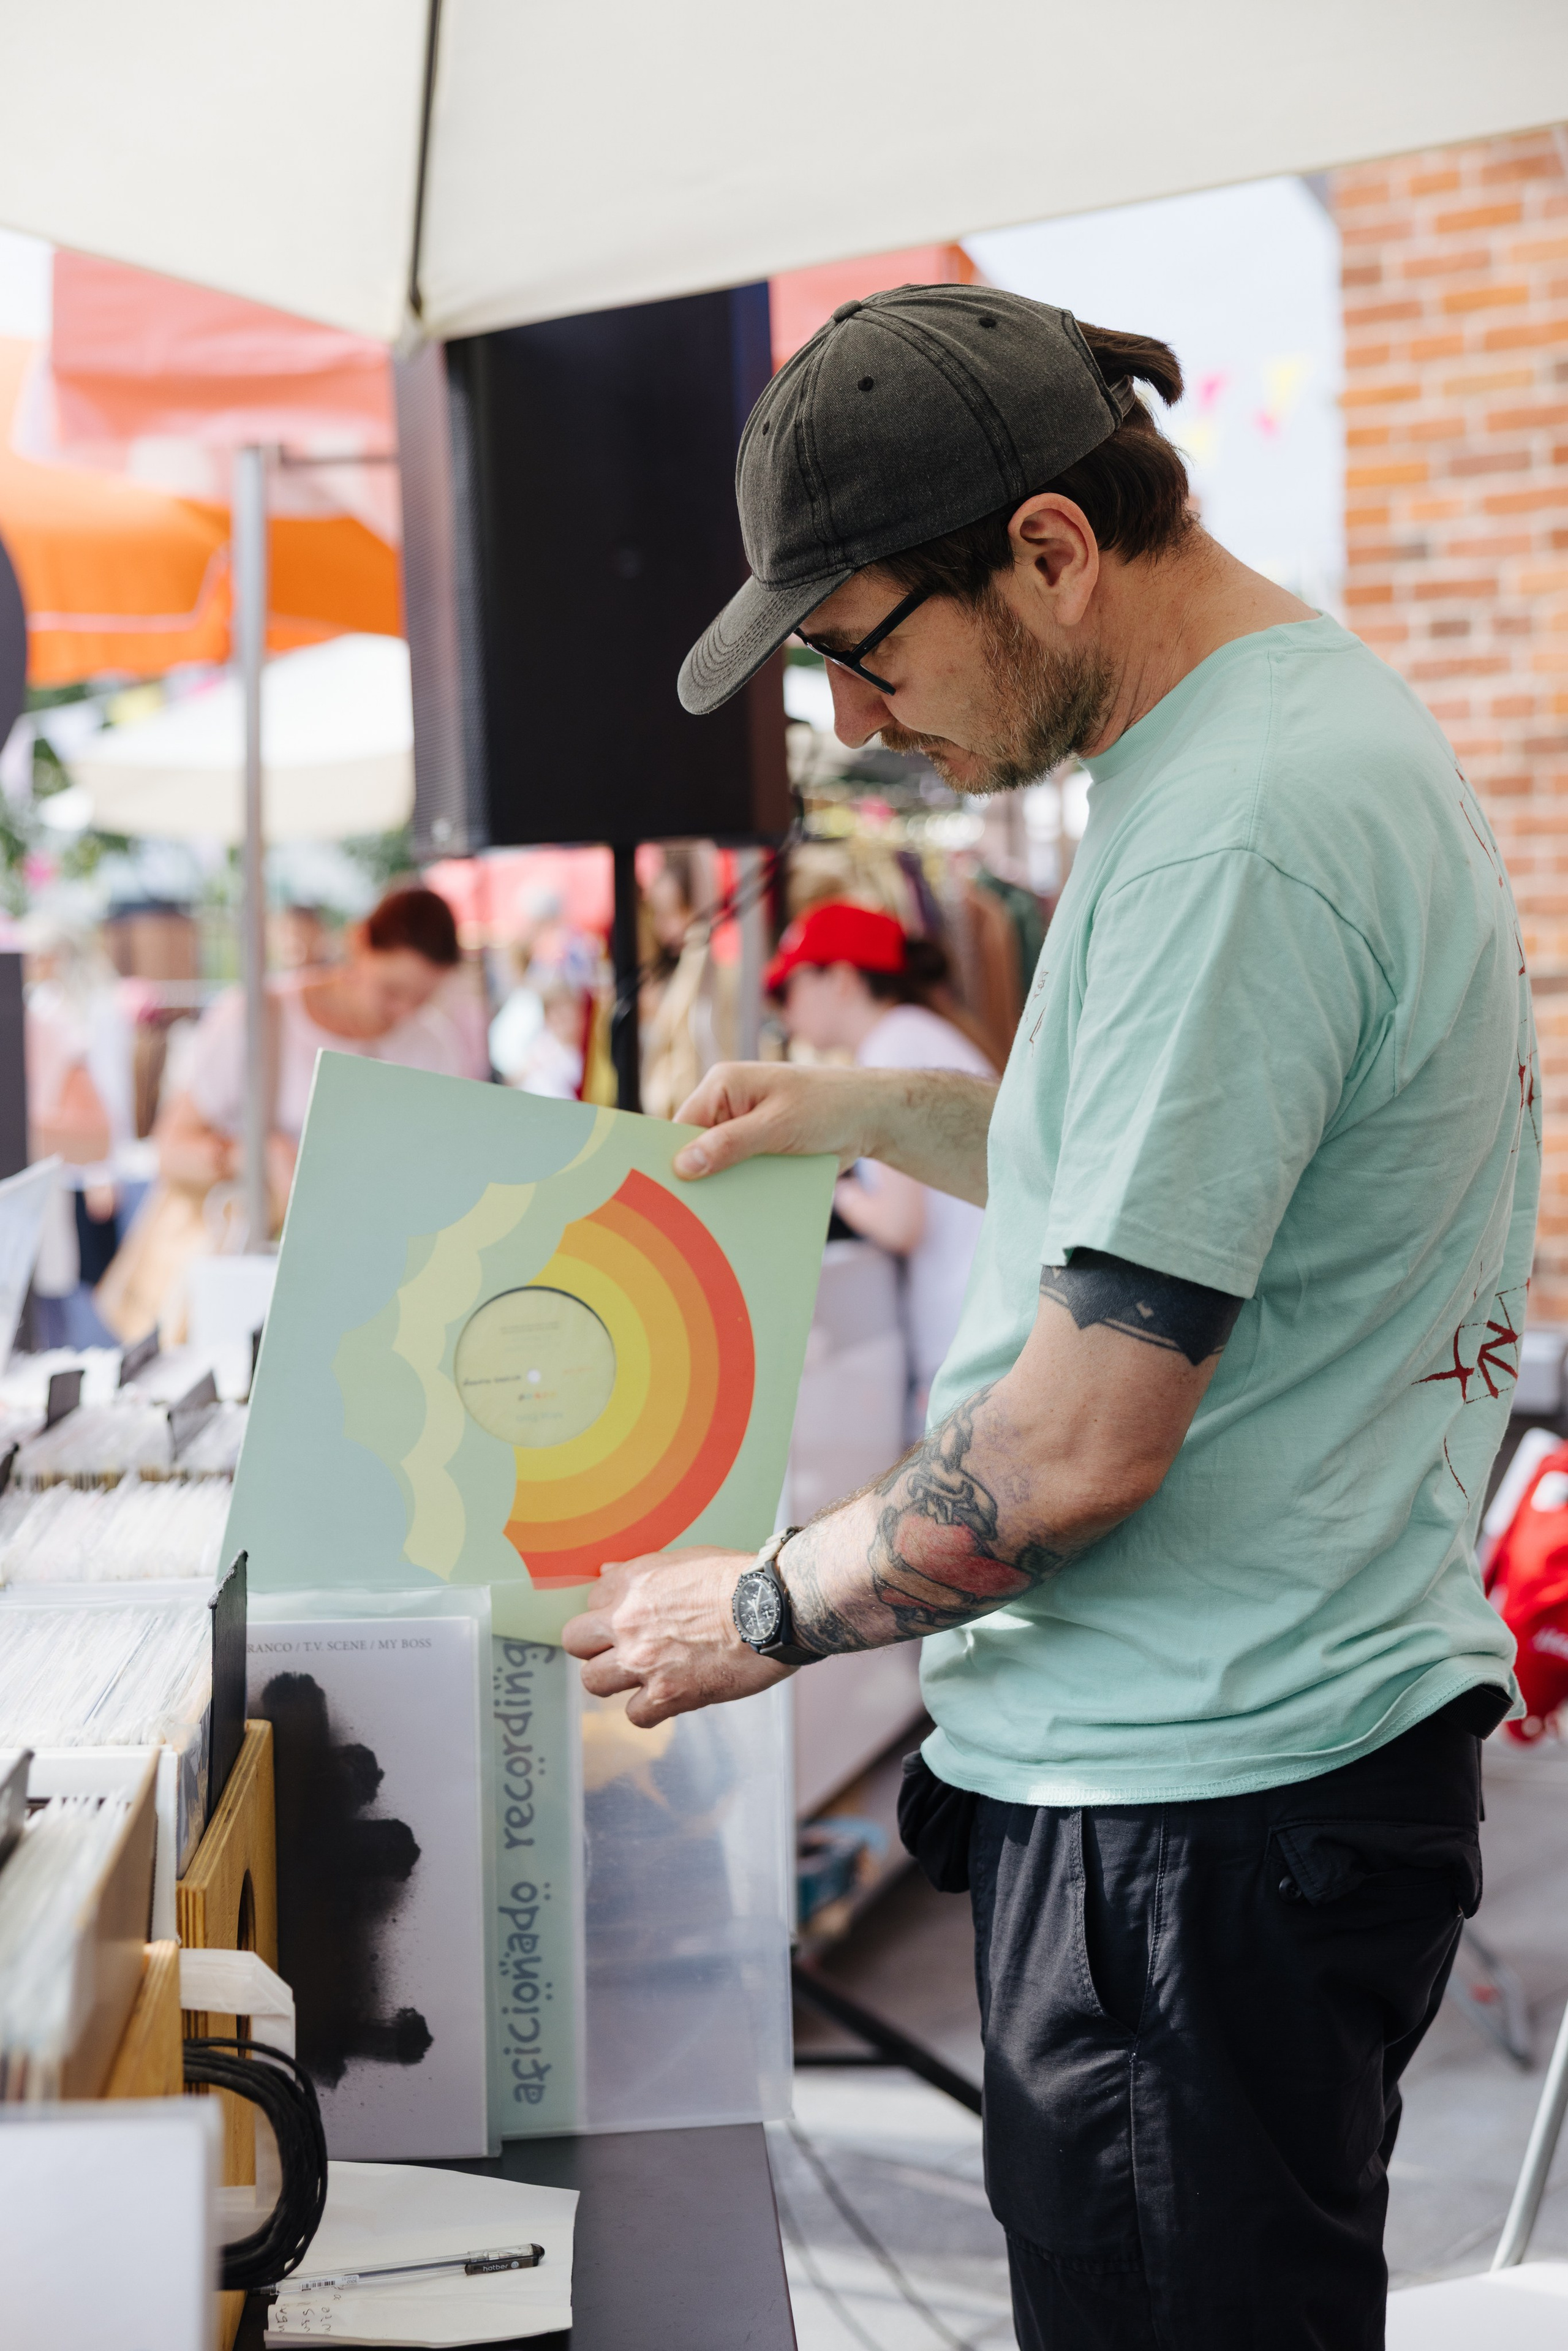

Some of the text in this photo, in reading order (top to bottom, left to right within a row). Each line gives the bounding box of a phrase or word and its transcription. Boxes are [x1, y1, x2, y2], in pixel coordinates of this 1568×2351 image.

[305, 1641, 323, 1652] T.V.
[327, 1640, 367, 1651] SCENE
[378, 1639, 398, 1650] MY
[401, 1638, 432, 1649] BOSS
[498, 1882, 553, 2105] aficionado
